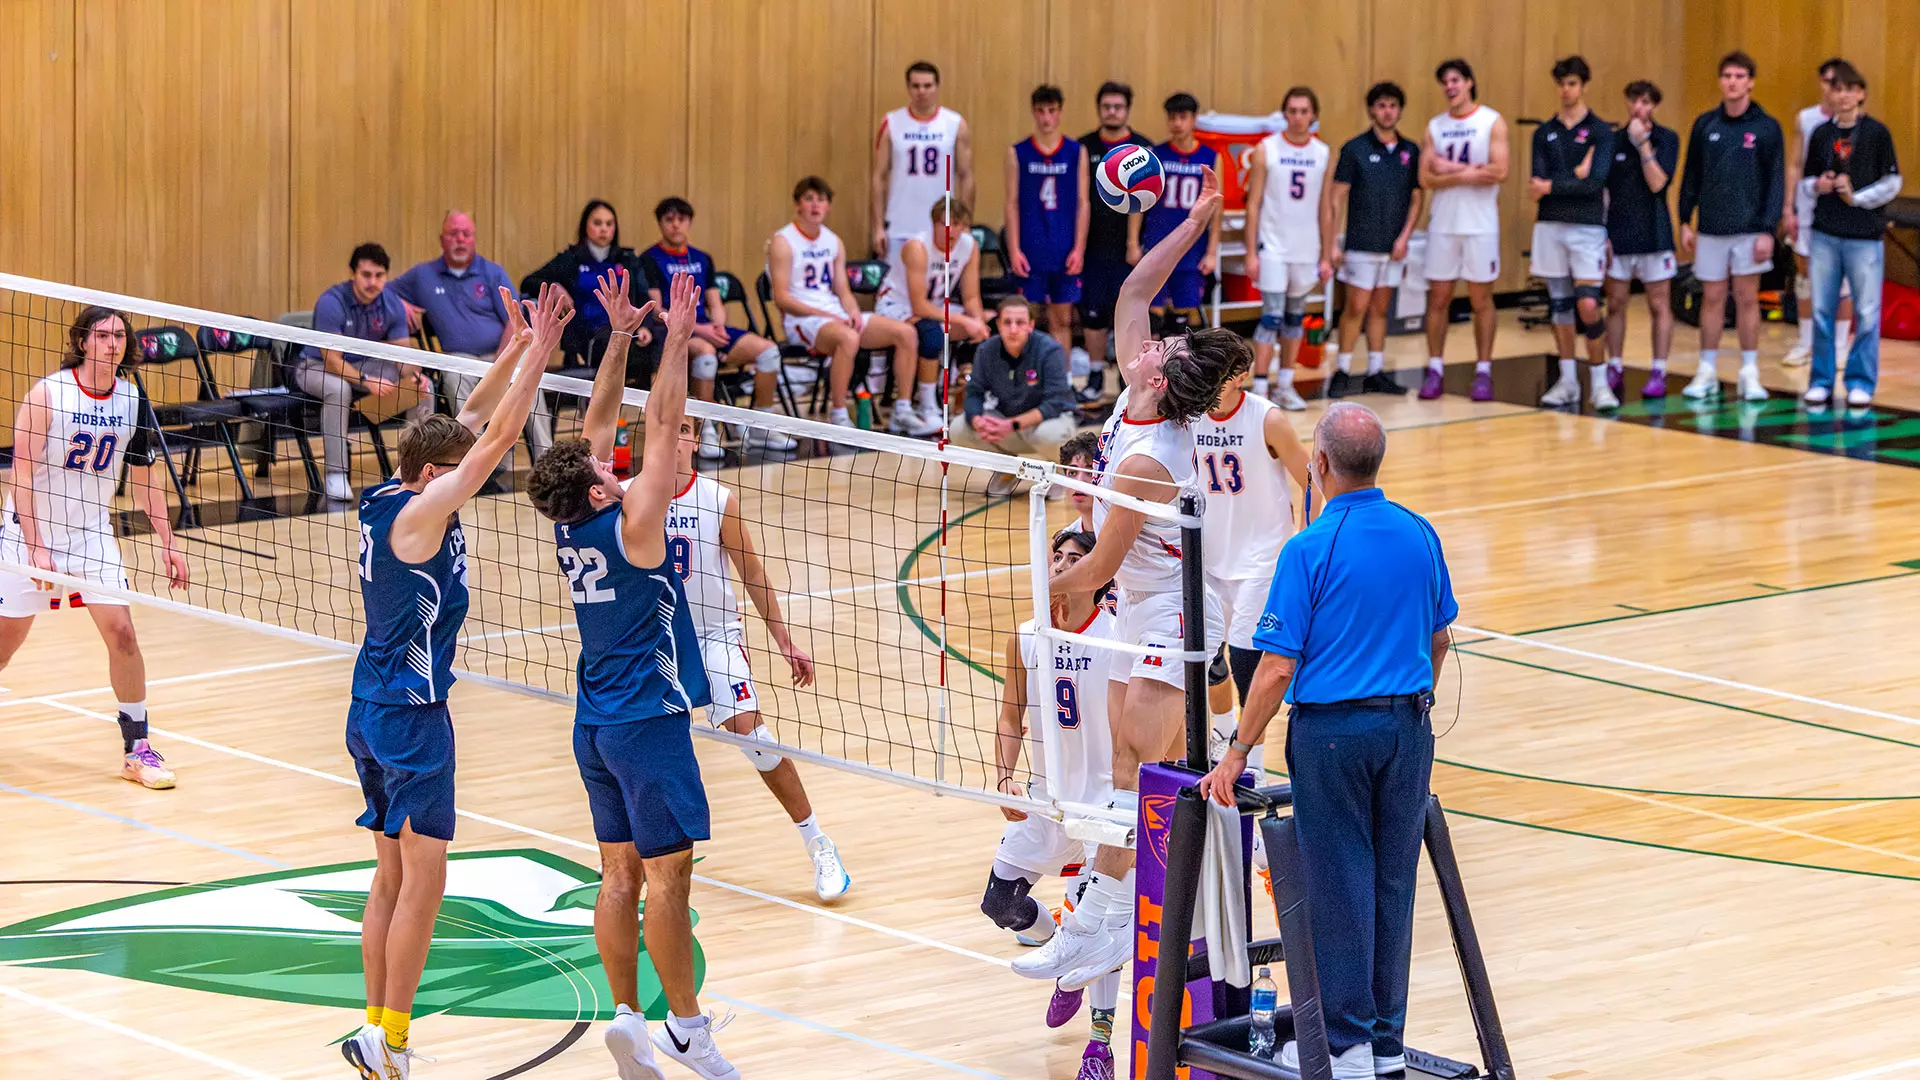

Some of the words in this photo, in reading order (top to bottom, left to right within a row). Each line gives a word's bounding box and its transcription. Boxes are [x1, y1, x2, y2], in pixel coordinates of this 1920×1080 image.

[908, 145, 938, 176] 18
[1122, 155, 1147, 171] NCAA
[1445, 141, 1471, 165] 14
[1039, 176, 1057, 210] 4
[1164, 175, 1201, 210] 10
[1290, 171, 1306, 200] 5
[804, 262, 833, 290] 24
[72, 412, 124, 427] HOBART
[64, 430, 119, 474] 20
[1197, 434, 1244, 447] HOBART
[1203, 451, 1245, 495] 13
[561, 525, 570, 539] T
[665, 516, 699, 529] ART
[557, 547, 616, 604] 22
[1054, 656, 1092, 671] BART
[1055, 676, 1081, 730] 9
